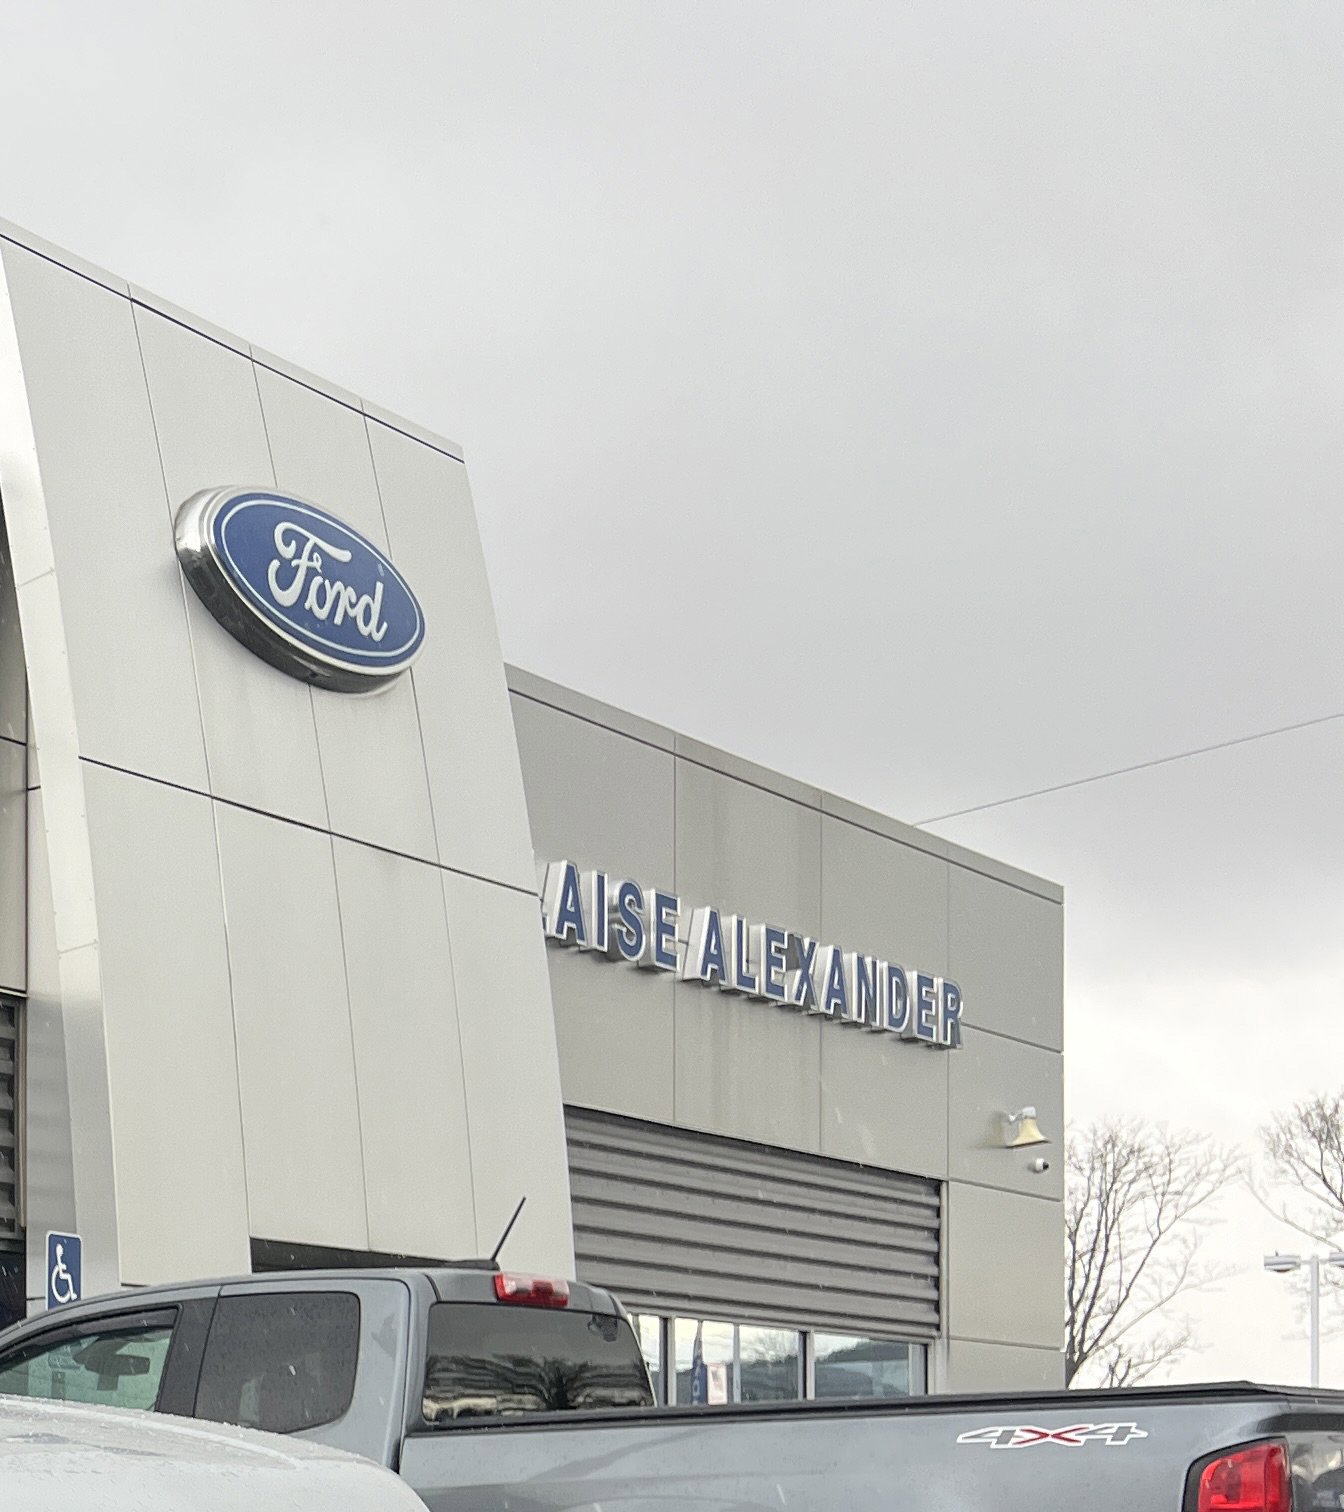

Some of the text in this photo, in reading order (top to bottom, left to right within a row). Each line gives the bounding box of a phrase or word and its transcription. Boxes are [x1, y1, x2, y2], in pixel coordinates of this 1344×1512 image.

[267, 521, 388, 642] Ford
[542, 860, 964, 1048] AISE ALEXANDER
